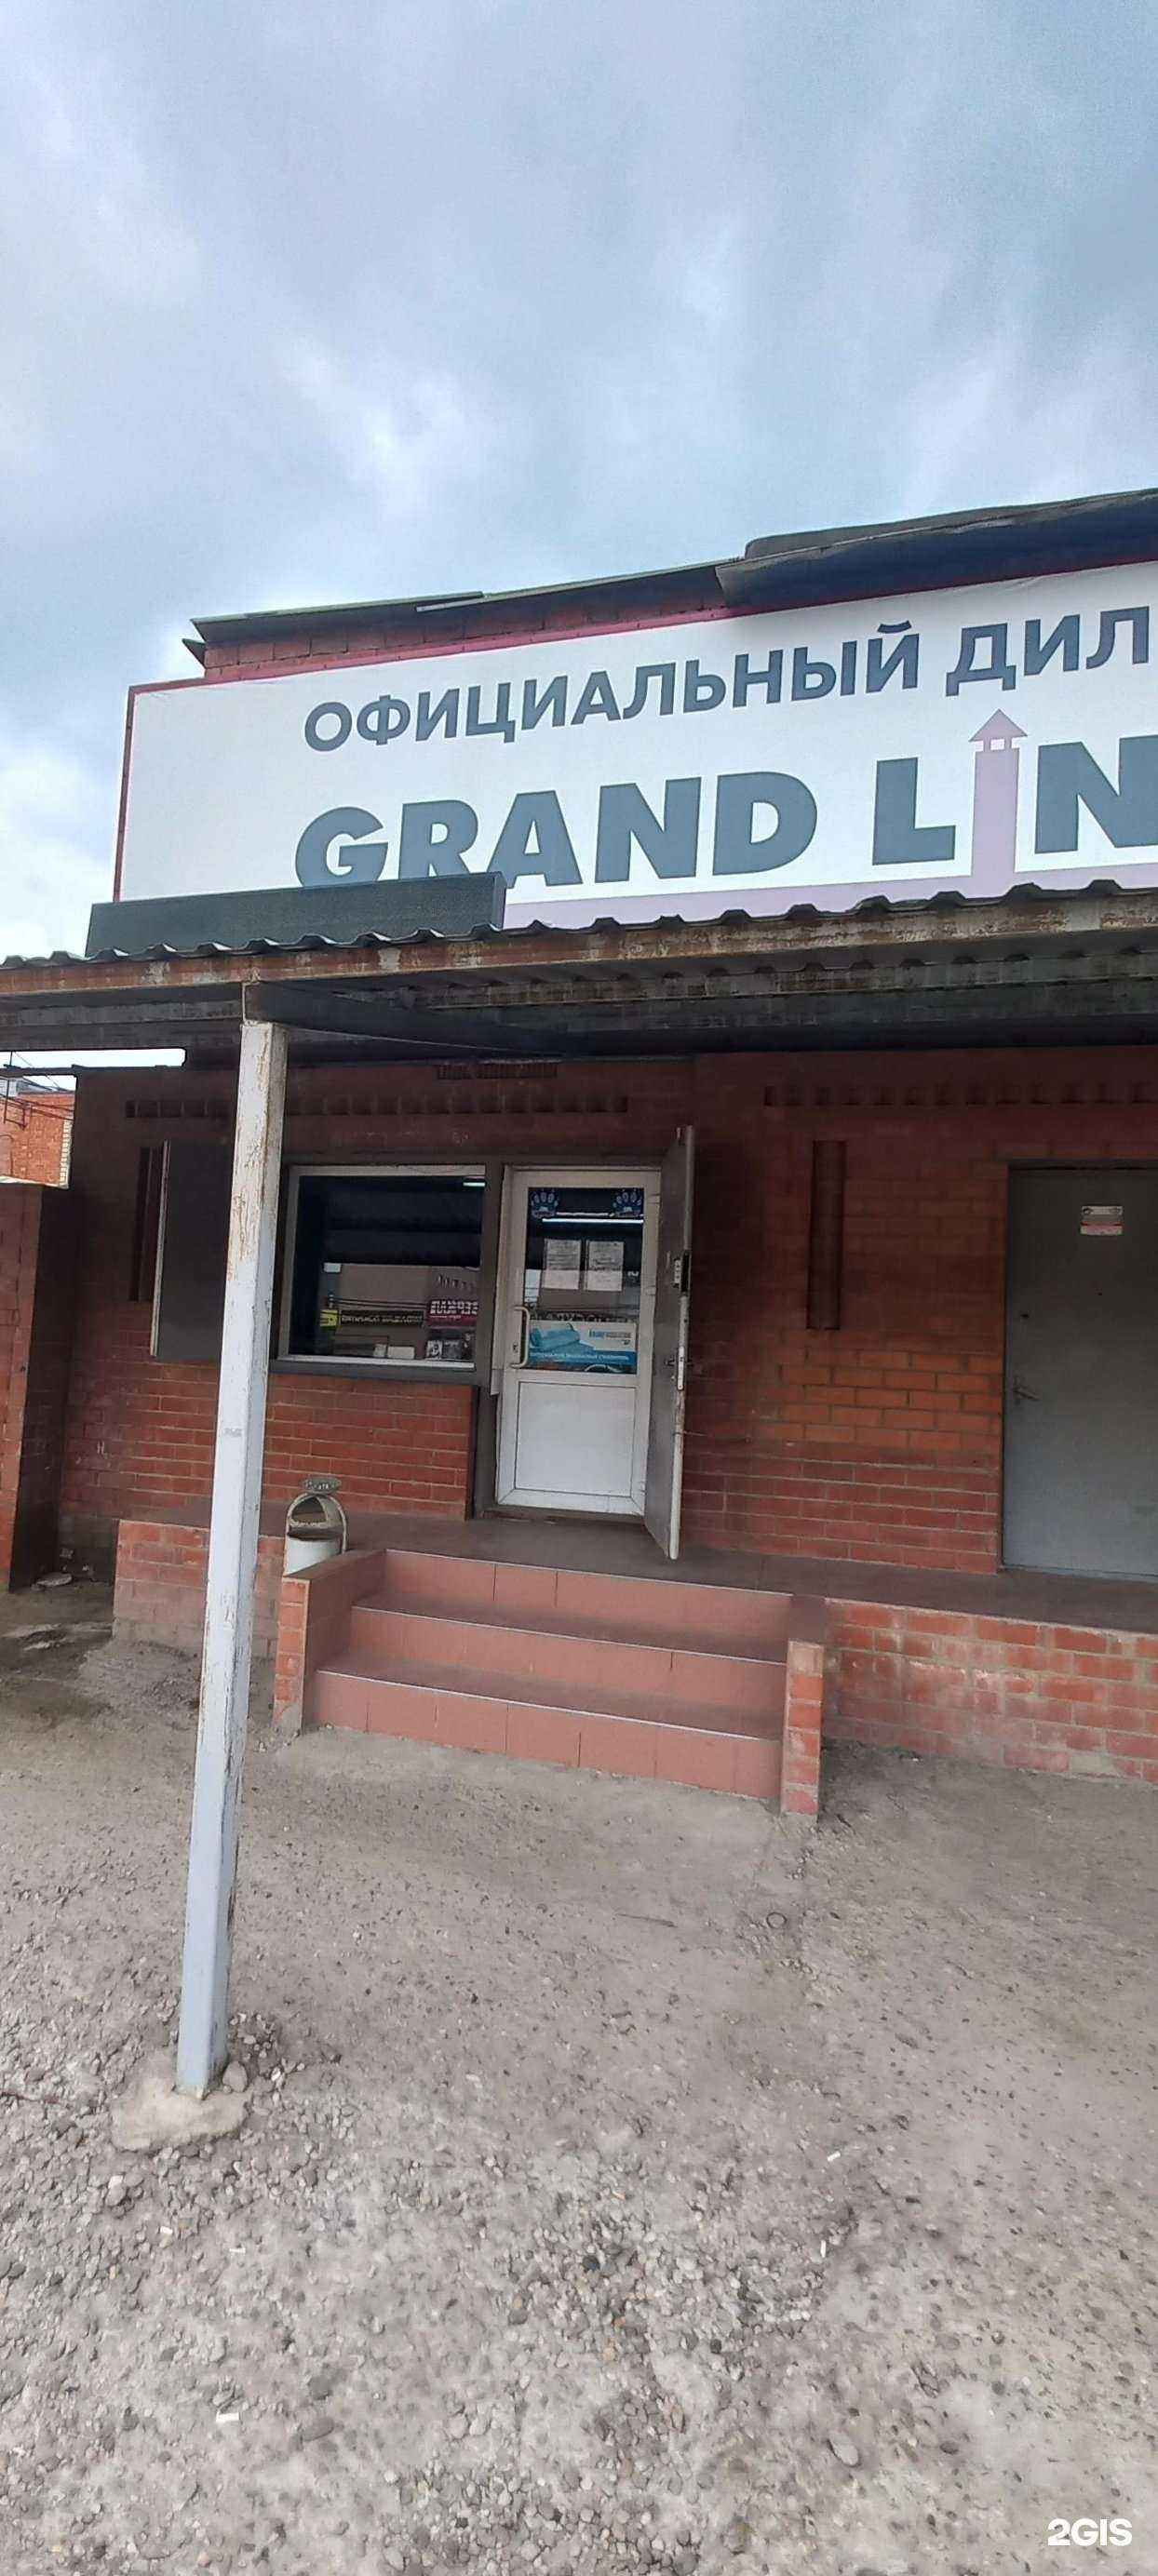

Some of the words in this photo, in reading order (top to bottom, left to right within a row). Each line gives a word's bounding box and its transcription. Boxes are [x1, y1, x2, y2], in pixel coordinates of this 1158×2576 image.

[304, 620, 920, 752] ОФИЦИАЛЬНЫЙ
[945, 606, 1151, 697] ДИЛ
[294, 771, 818, 889] GRAND
